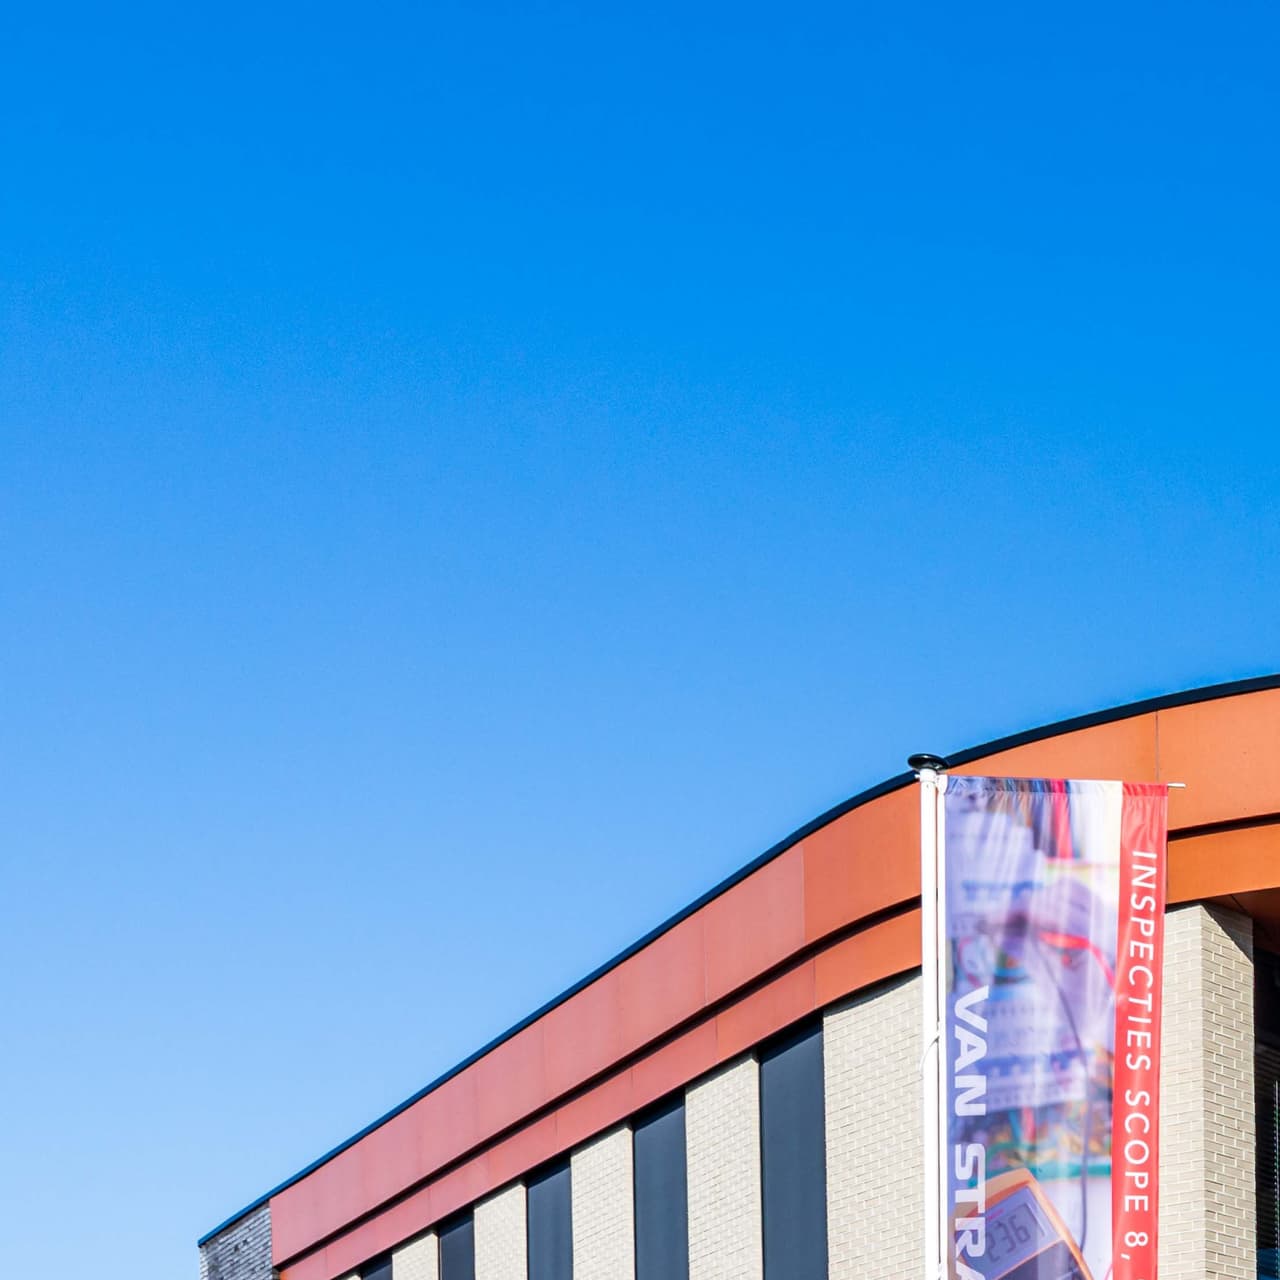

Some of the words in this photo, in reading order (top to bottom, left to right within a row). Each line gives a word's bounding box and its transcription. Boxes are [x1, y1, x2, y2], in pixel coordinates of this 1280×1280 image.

[1125, 847, 1158, 1073] INSPECTIES
[954, 984, 990, 1117] VAN
[1122, 1089, 1151, 1213] SCOPE
[1120, 1231, 1149, 1261] 8,
